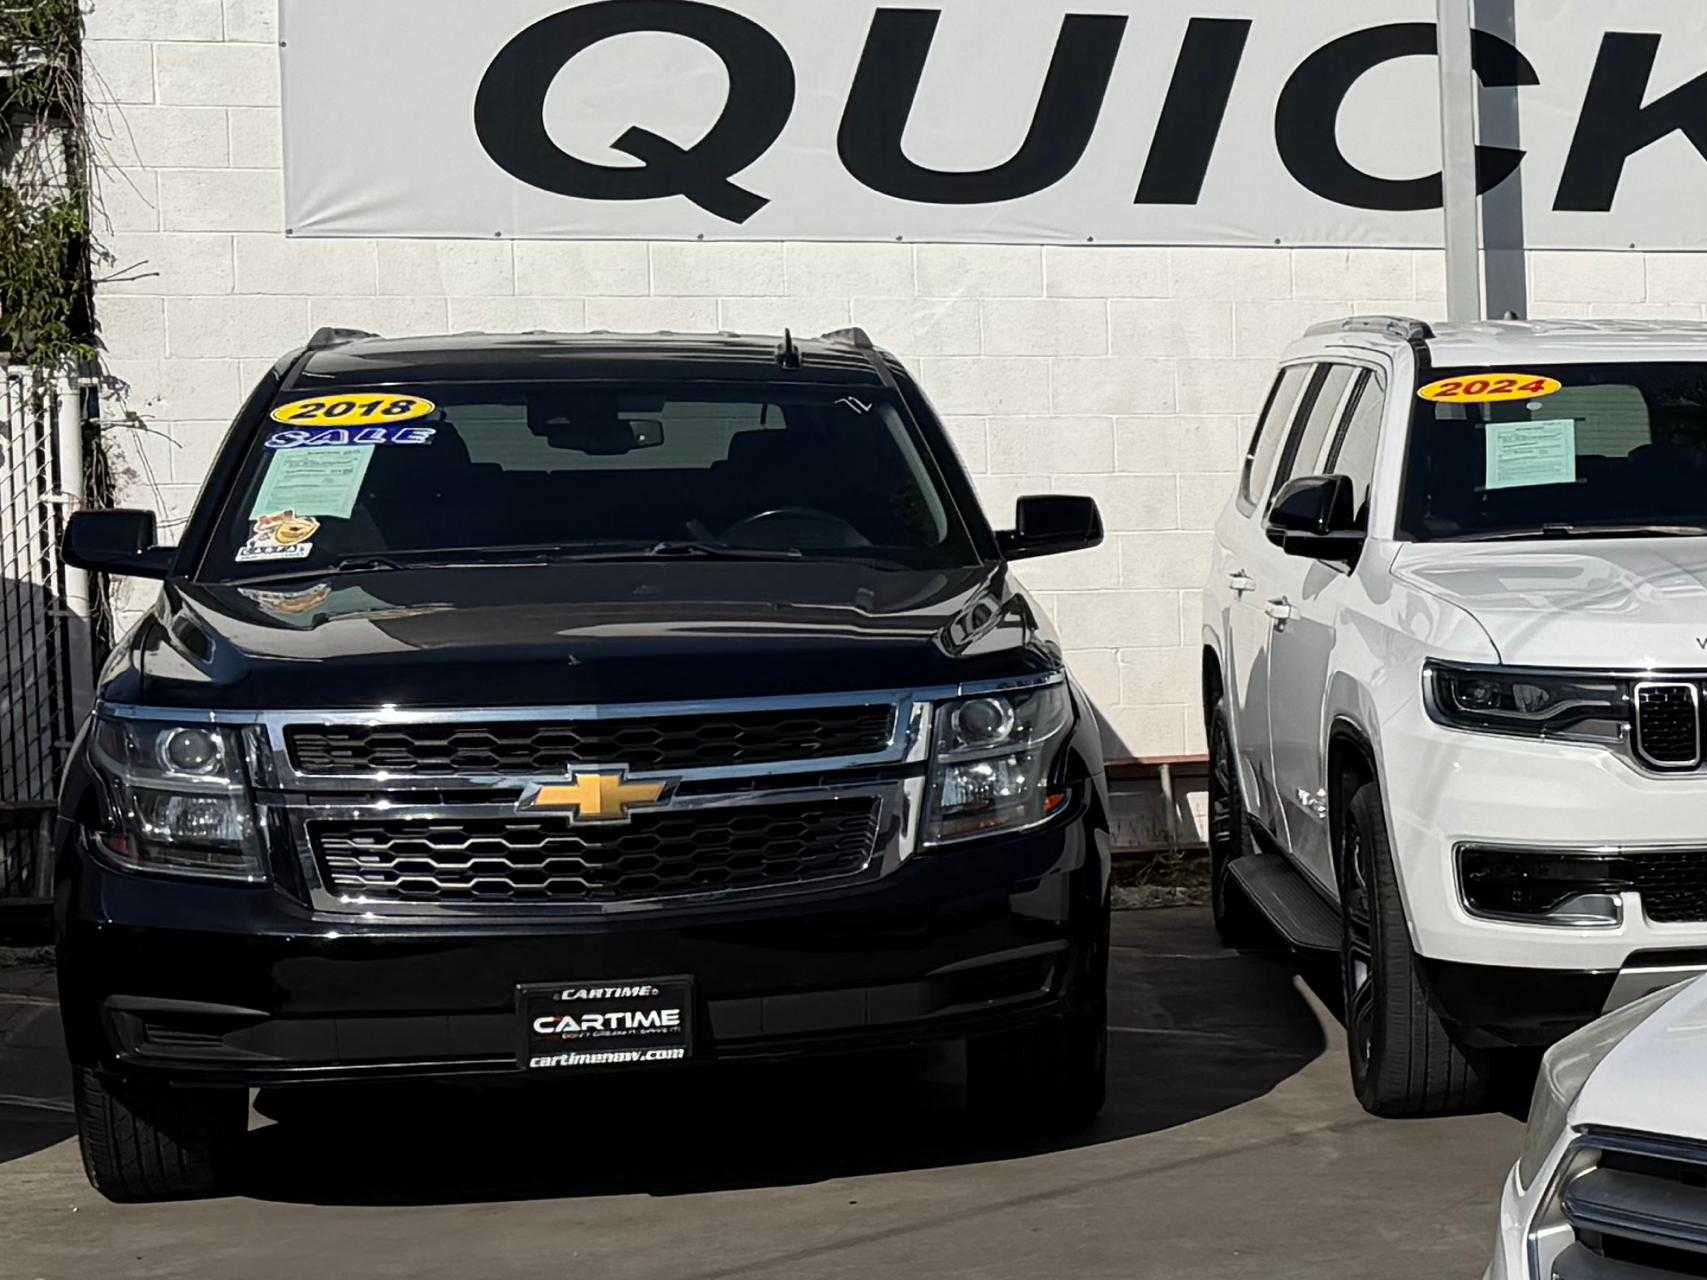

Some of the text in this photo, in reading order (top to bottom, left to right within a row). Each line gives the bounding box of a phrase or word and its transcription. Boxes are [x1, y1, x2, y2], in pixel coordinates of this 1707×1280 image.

[1432, 378, 1546, 398] 2024
[287, 399, 417, 420] 2018
[264, 427, 437, 448] SALE
[561, 985, 652, 1001] CARTIME
[532, 1008, 681, 1034] CARTIME
